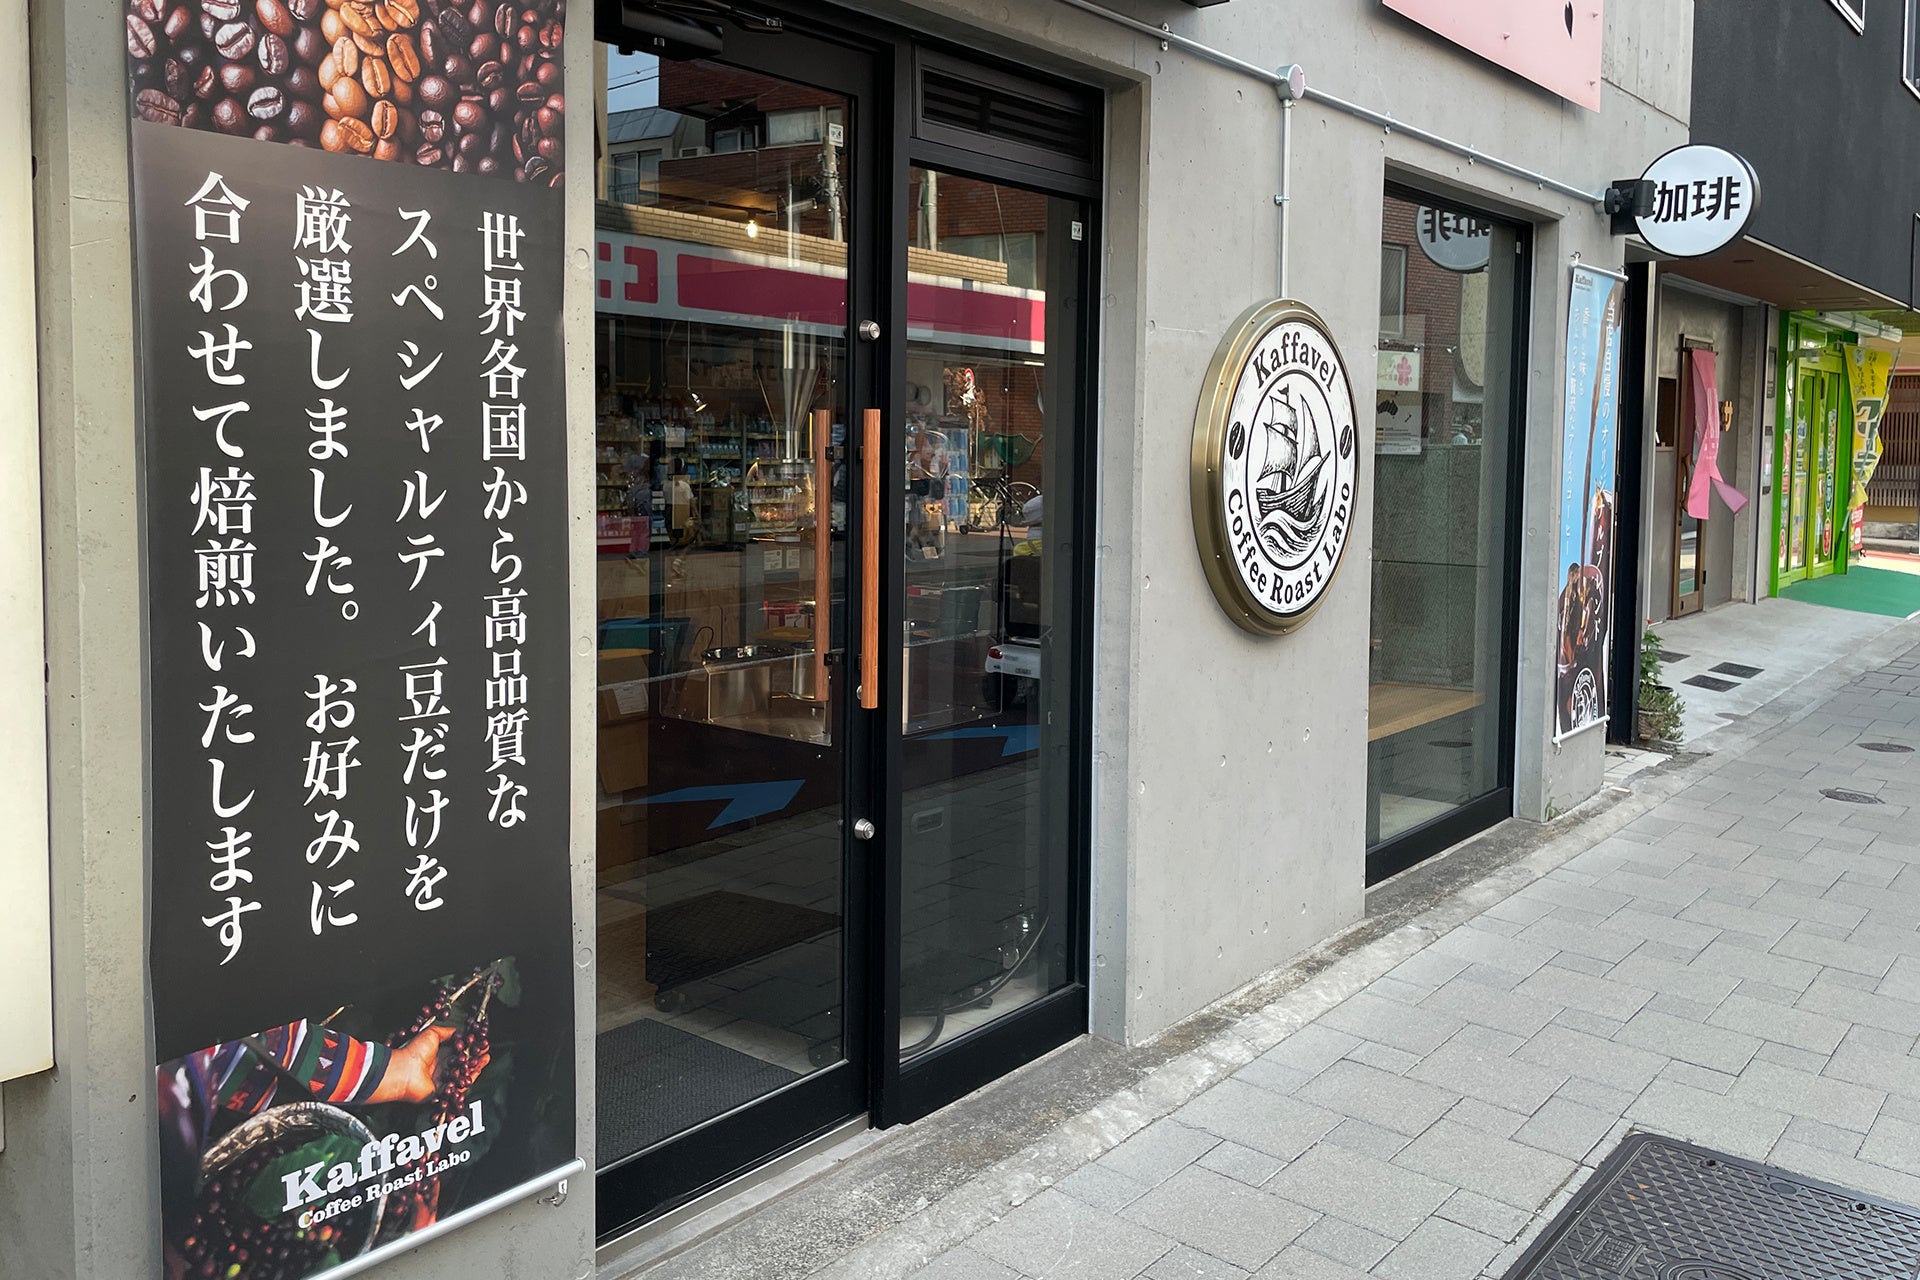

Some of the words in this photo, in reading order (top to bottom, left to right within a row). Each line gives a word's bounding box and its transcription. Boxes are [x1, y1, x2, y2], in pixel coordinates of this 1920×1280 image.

[1253, 331, 1337, 392] Kaffavel
[184, 171, 262, 966] 合わせて焙煎いたします
[391, 207, 451, 911] スペシャルティ豆だけを
[477, 211, 530, 828] 世界各国から高品質な
[1228, 488, 1267, 593] Coffee
[1269, 564, 1323, 605] Roast
[1324, 482, 1350, 566] Labo
[281, 1100, 485, 1212] Kaffavel
[298, 1192, 362, 1229] Coffee
[365, 1168, 424, 1202] Roast
[426, 1150, 471, 1177] Labo
